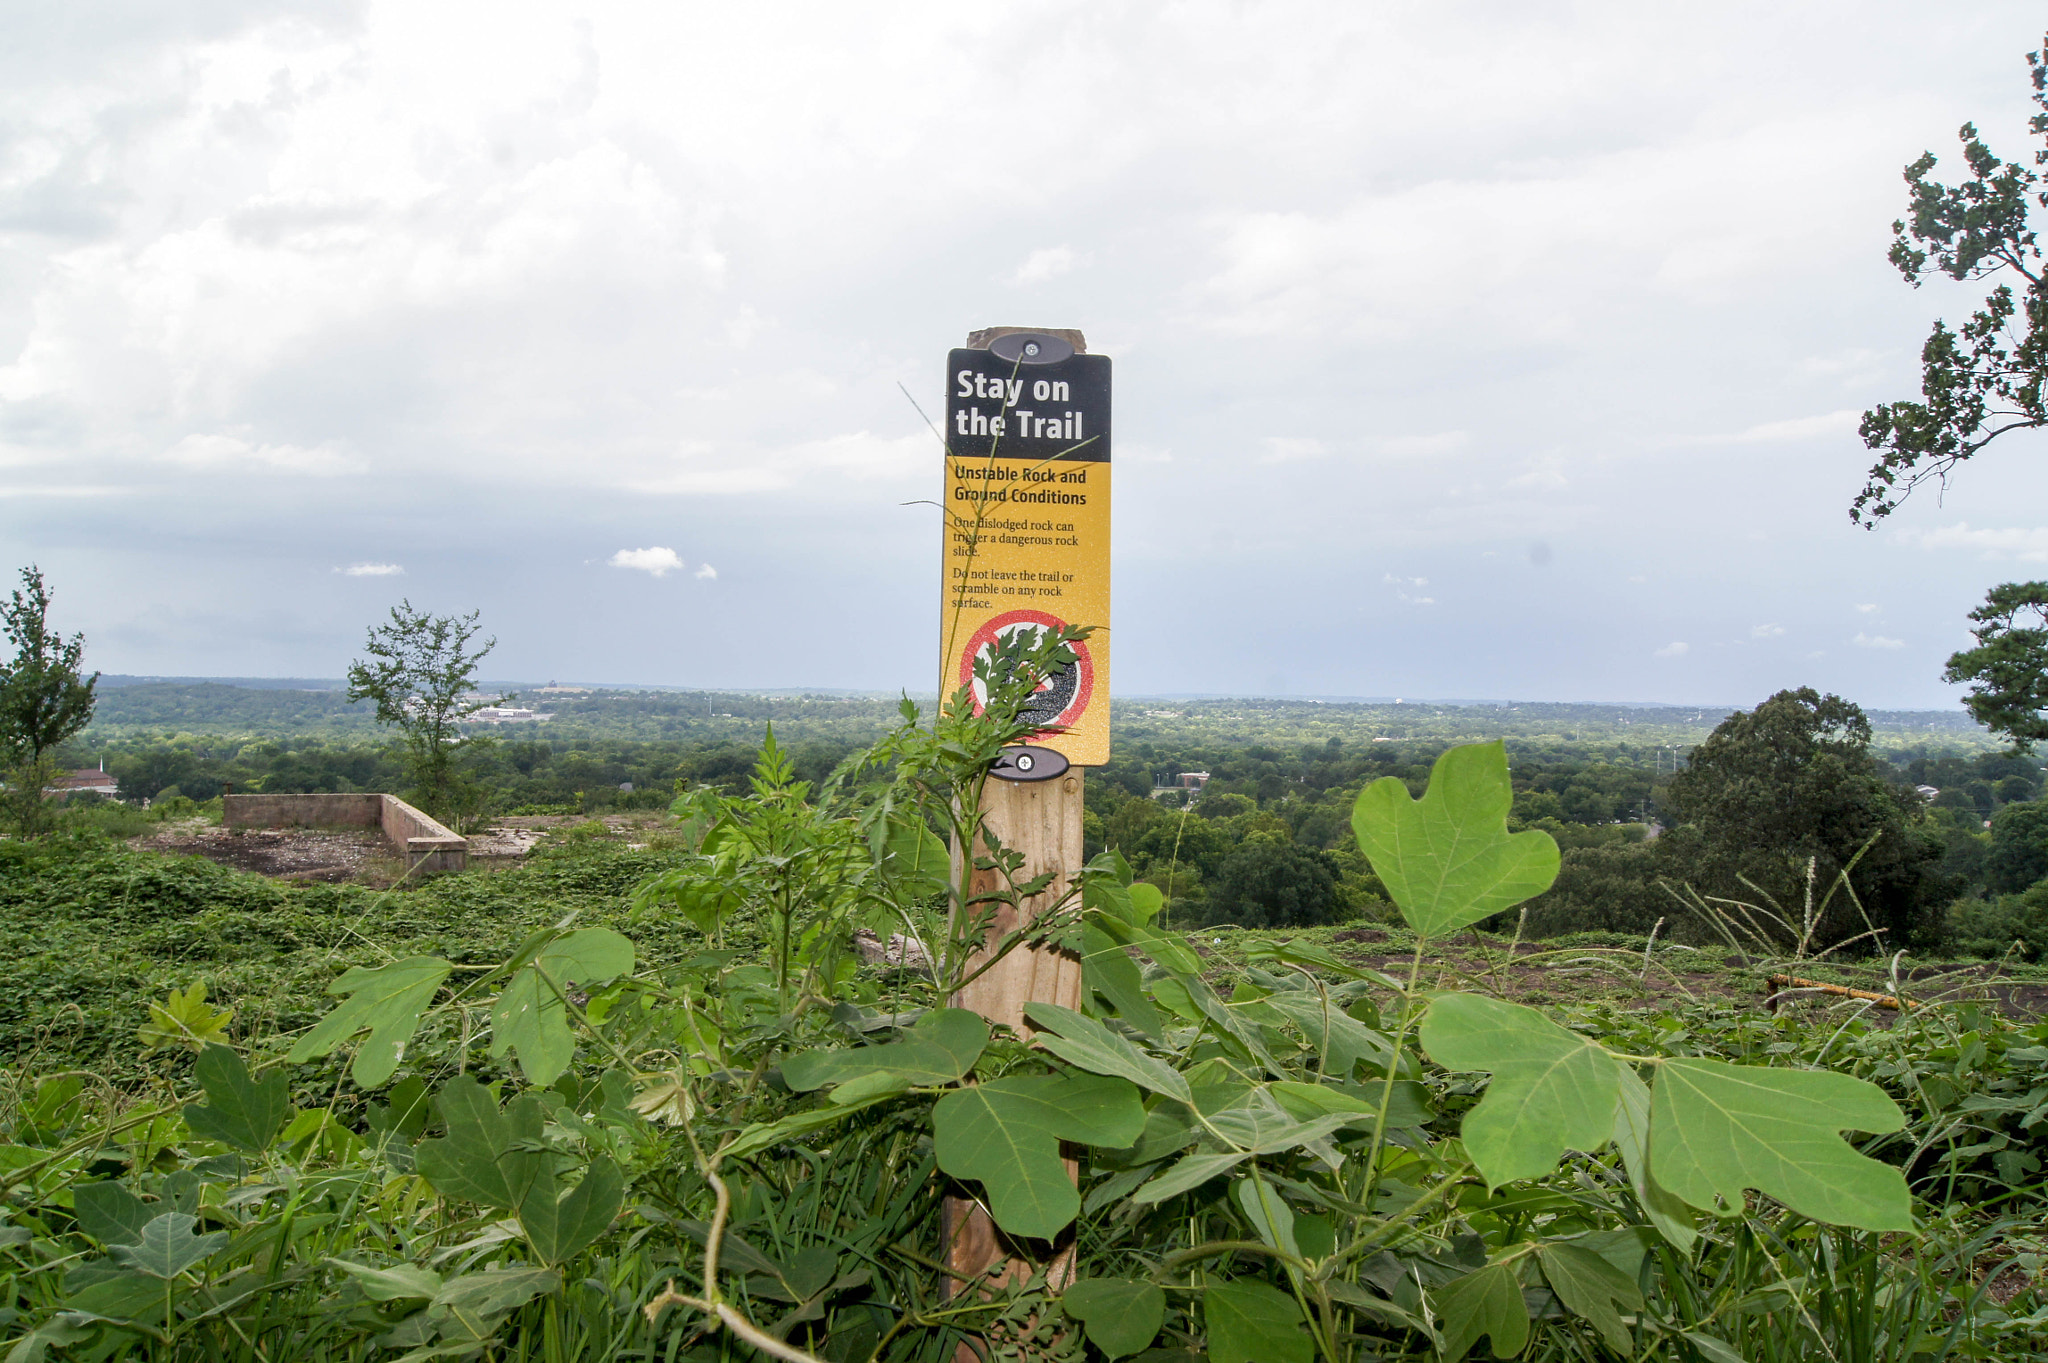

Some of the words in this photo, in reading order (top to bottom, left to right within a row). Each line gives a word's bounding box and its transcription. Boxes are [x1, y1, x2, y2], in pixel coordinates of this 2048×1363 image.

[958, 370, 1023, 407] Stay
[1034, 380, 1069, 401] on
[956, 407, 1006, 436] the
[1016, 411, 1082, 439] Trail
[955, 465, 1018, 480] Unstable
[1023, 468, 1055, 482] Rock
[1060, 470, 1086, 483] and
[955, 487, 1006, 502] Ground
[1012, 489, 1086, 505] Conditions
[954, 517, 975, 528] One
[977, 517, 1027, 531] dislodged
[1030, 519, 1053, 530] rock
[1056, 522, 1074, 532] can
[991, 535, 996, 543] a
[999, 533, 1052, 547] dangerous
[1056, 534, 1078, 546] rock
[953, 568, 968, 578] Do
[971, 570, 988, 580] not
[991, 569, 1017, 580] leave
[1020, 570, 1036, 581] the
[1039, 571, 1059, 582] trail
[1062, 574, 1073, 582] or
[952, 583, 999, 594] scramble
[1002, 587, 1015, 595] on
[1018, 587, 1037, 598] any
[1039, 585, 1062, 596] rock
[952, 598, 992, 608] surface.
